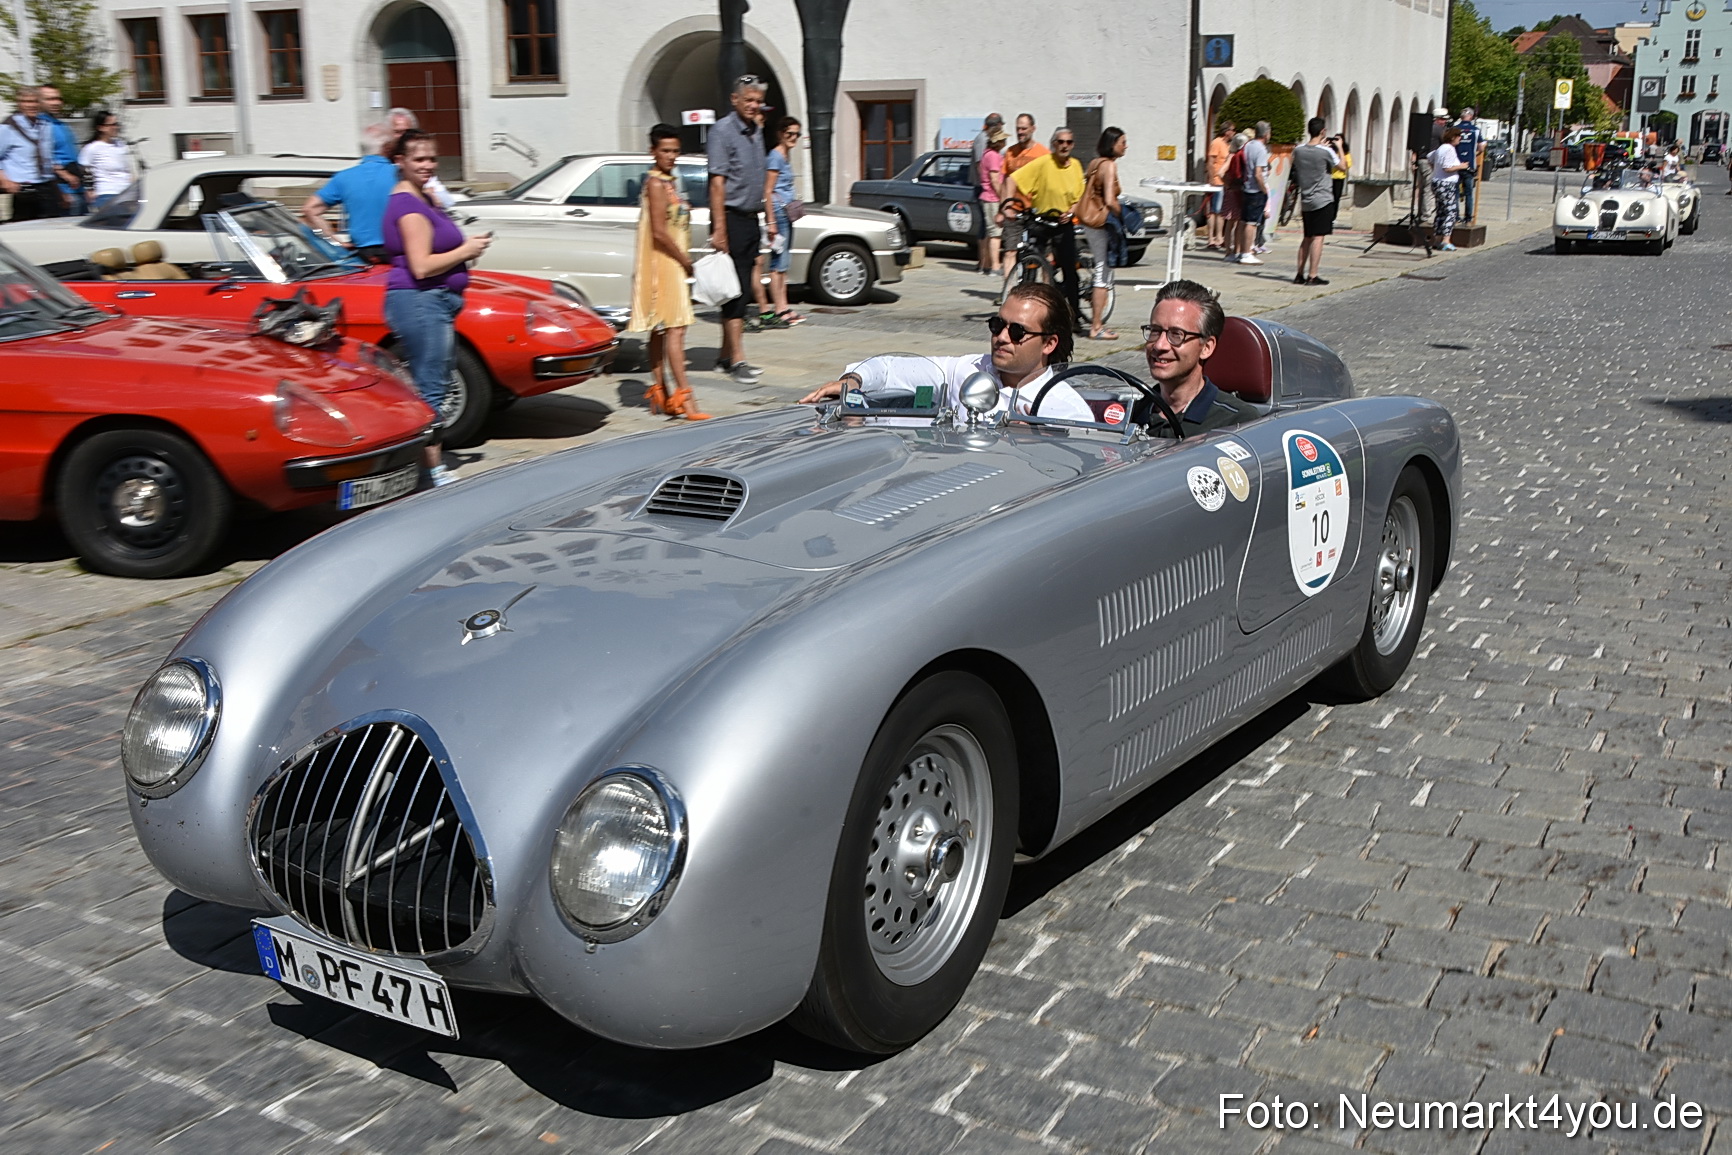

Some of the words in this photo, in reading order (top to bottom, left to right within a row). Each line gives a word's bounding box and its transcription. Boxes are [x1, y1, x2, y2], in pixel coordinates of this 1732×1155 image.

[1229, 470, 1245, 489] 14
[1312, 509, 1330, 547] 10
[264, 955, 274, 969] D
[272, 935, 301, 983] M
[316, 949, 364, 1001] PF
